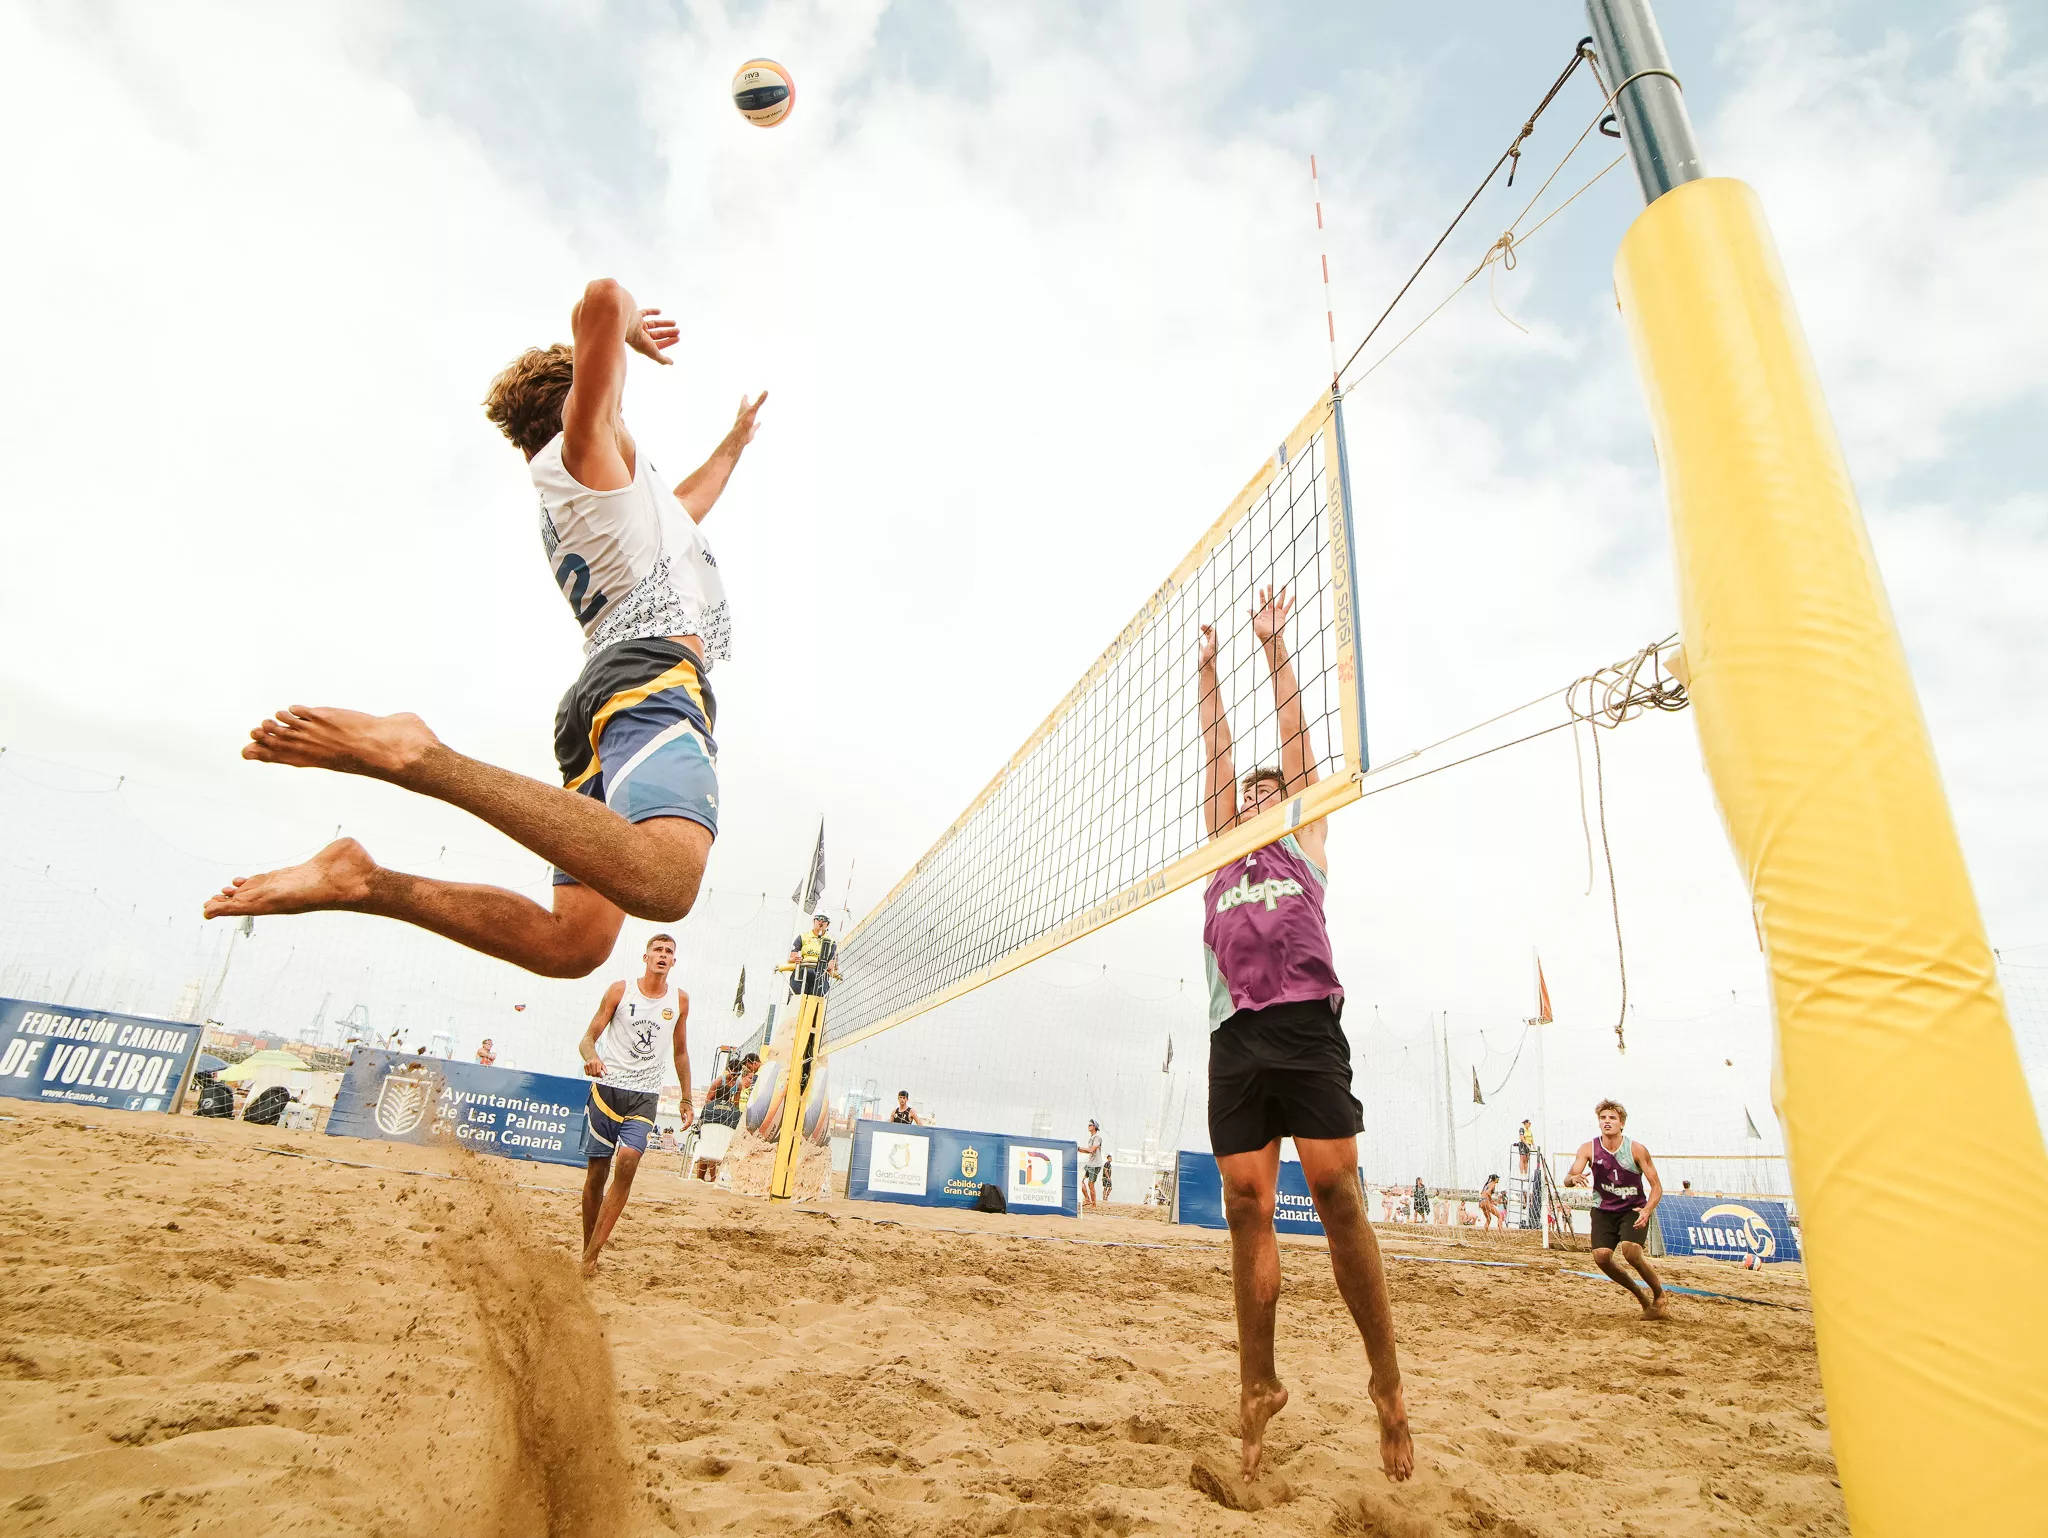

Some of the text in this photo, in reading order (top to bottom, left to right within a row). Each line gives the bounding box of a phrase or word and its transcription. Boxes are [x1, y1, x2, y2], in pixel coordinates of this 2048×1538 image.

[1329, 476, 1352, 650] Islas Canarias
[555, 553, 608, 629] 2
[1216, 873, 1305, 912] udapa
[17, 1011, 188, 1054] FEDERACIÓN CANARIA
[0, 1038, 175, 1096] DE VOLEIBOL
[41, 1088, 109, 1104] www.fcanvb.es
[440, 1086, 570, 1118] Ayuntamiento
[436, 1103, 567, 1135] de Las Palmas
[456, 1123, 497, 1143] Gran
[501, 1129, 563, 1151] Canaria
[947, 1178, 977, 1189] Cabildo
[1613, 1169, 1619, 1181] 1
[943, 1186, 981, 1197] Gran Cana
[1601, 1182, 1638, 1200] udapa
[1274, 1206, 1322, 1223] Canaria
[1687, 1226, 1747, 1248] FIVBGC
